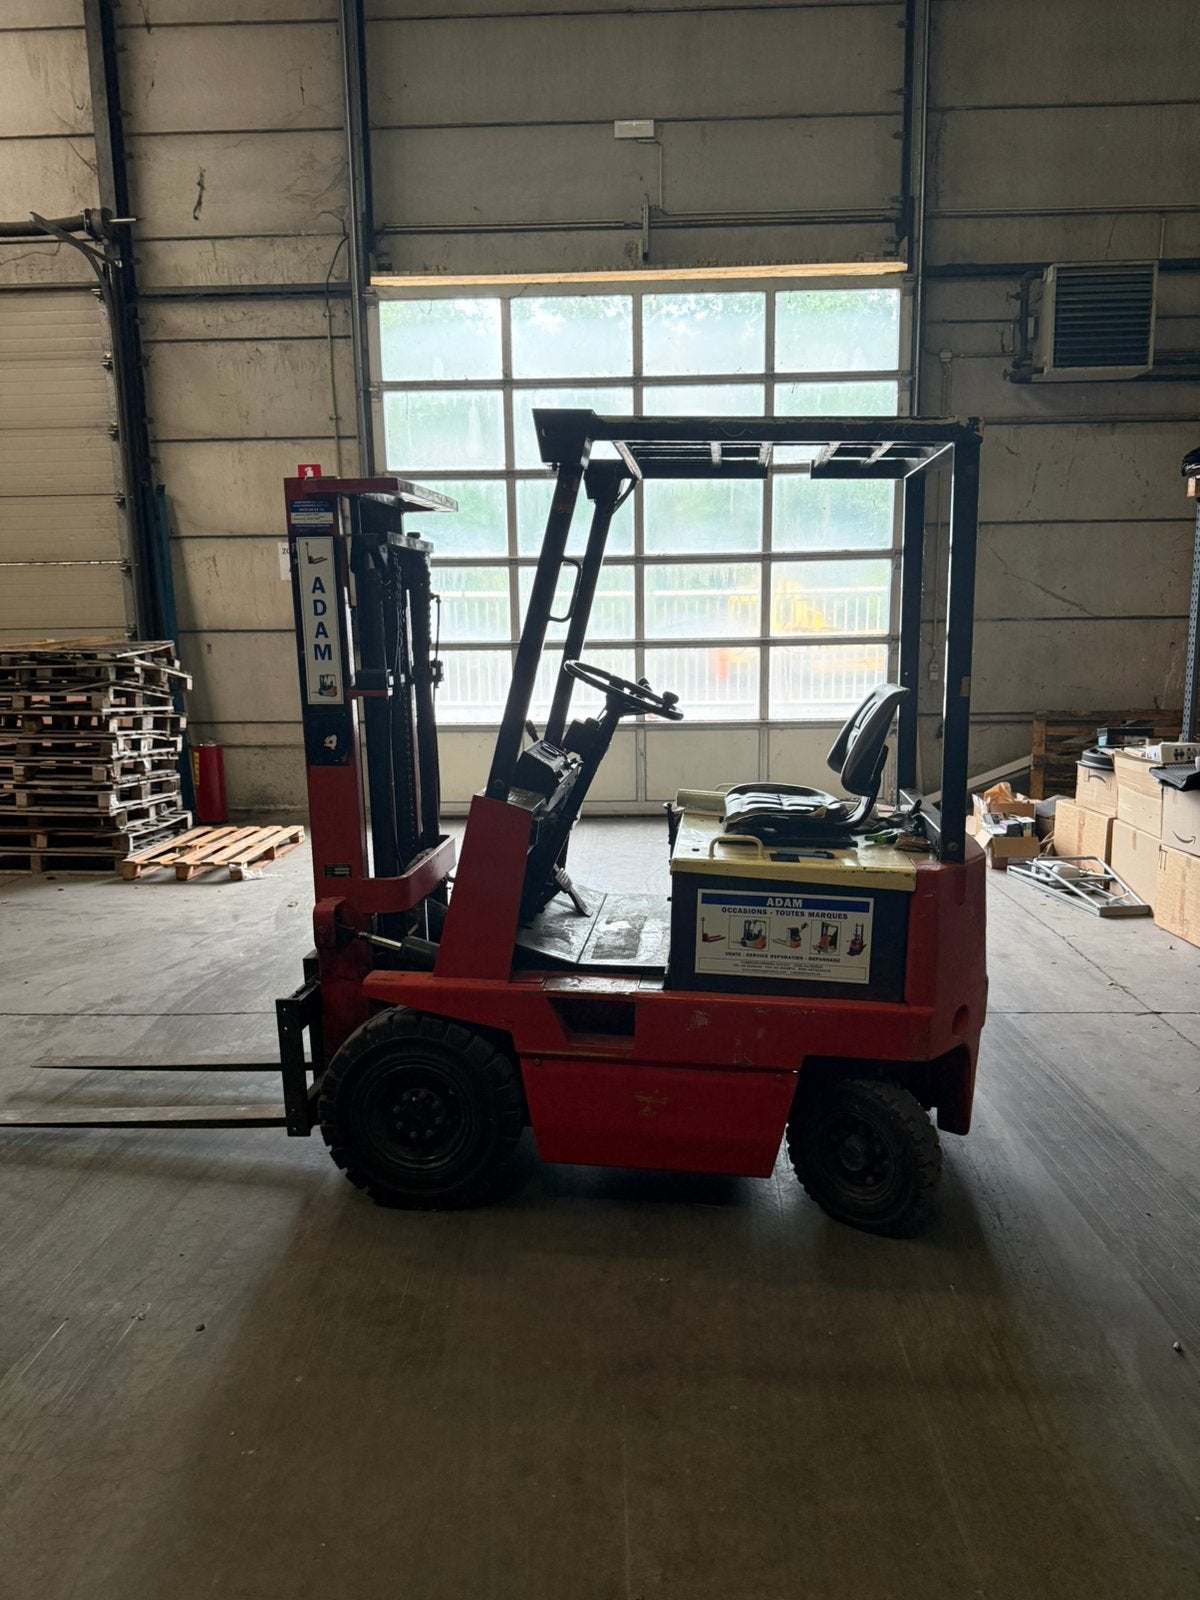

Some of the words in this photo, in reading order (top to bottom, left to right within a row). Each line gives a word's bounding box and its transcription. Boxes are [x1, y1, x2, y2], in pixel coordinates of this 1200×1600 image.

[311, 576, 333, 661] ADAM
[766, 897, 803, 909] ADAM
[721, 906, 768, 916] OCCASIONS
[775, 909, 805, 918] TOUTES
[807, 911, 848, 920] MARQUES
